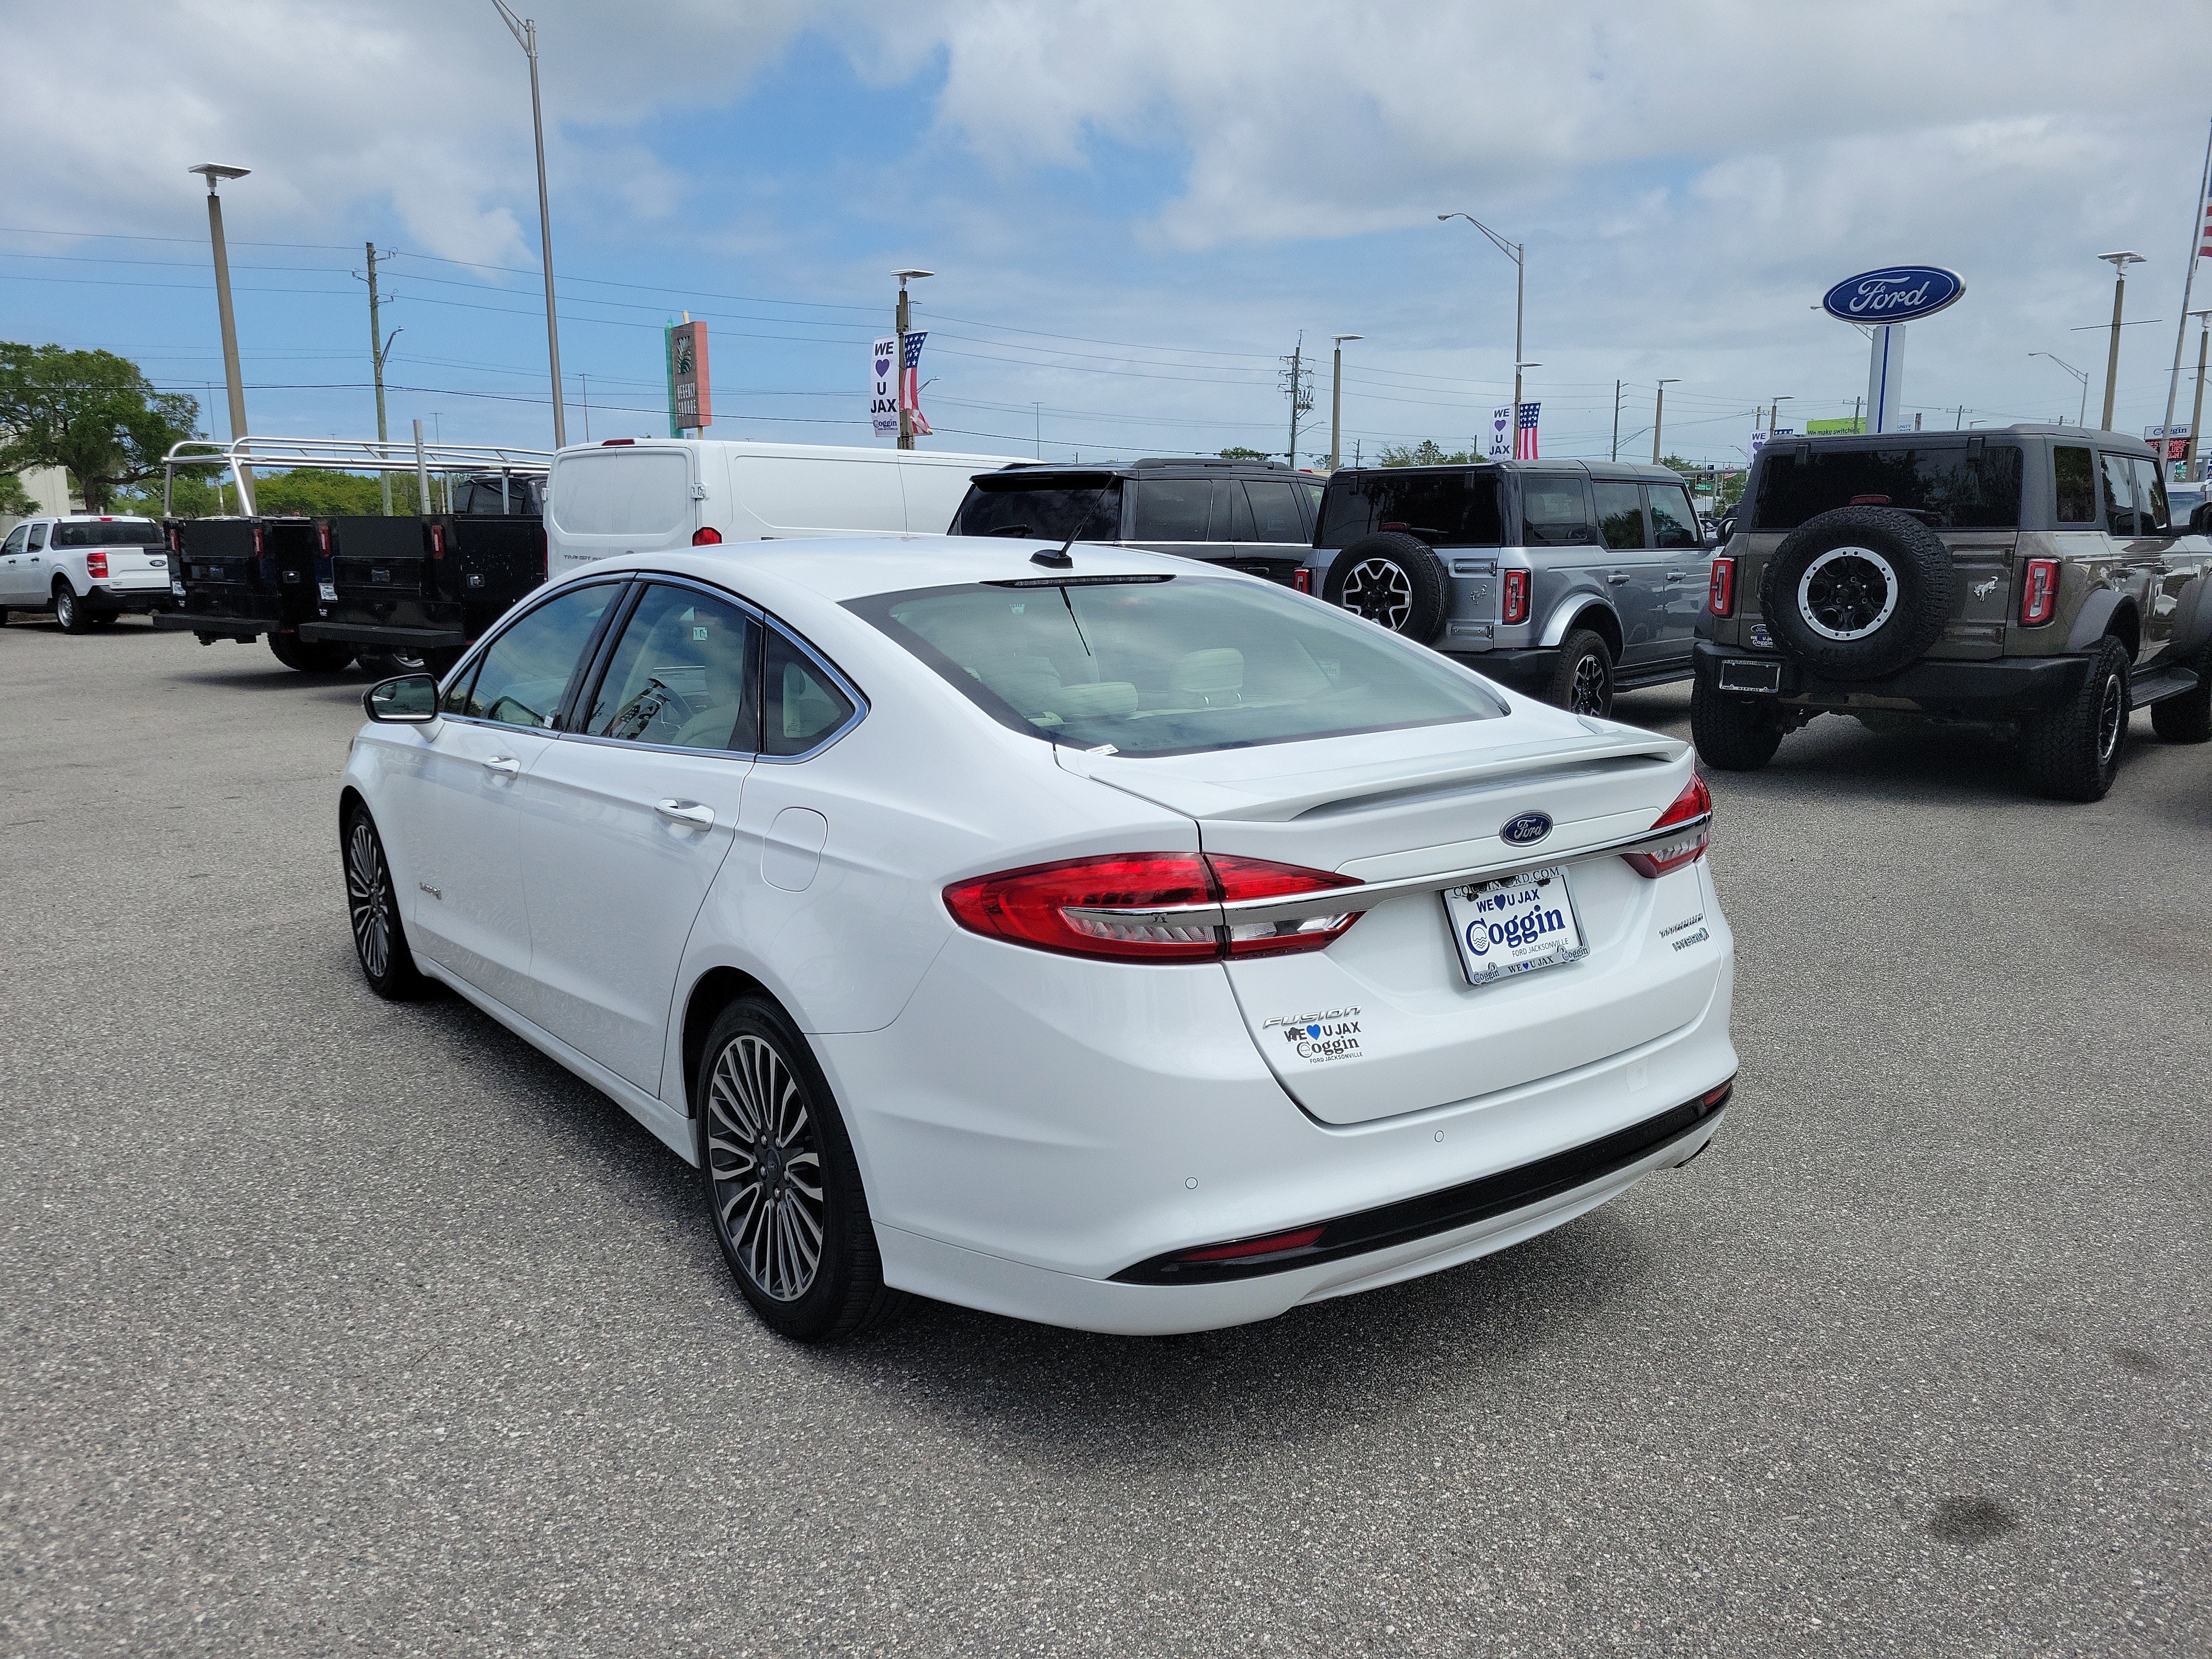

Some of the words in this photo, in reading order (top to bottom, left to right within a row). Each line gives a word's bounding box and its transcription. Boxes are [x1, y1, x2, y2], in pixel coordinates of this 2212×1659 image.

[1849, 276, 1931, 312] Ford
[874, 341, 894, 356] WE
[677, 382, 695, 399] REGENCY
[877, 382, 887, 395] U
[678, 399, 696, 417] SQUARE
[871, 399, 897, 413] JAX
[1494, 408, 1510, 418] WE
[873, 419, 897, 428] Coggin
[2153, 427, 2187, 436] Cgin
[1496, 435, 1503, 443] U
[1489, 445, 1510, 455] JAX
[1514, 818, 1544, 839] Ford
[1476, 898, 1494, 913] WE
[1508, 893, 1515, 906] U
[1517, 888, 1541, 904] JAX
[1466, 904, 1566, 956] Coggin
[1511, 949, 1527, 958] FORD
[1528, 938, 1569, 955] JACKSONVILLE
[1474, 969, 1500, 983] Coggin
[1508, 965, 1522, 974] WE
[1537, 956, 1554, 966] JAX
[1562, 947, 1589, 961] Coggin
[1262, 1005, 1362, 1030] FUSION
[1322, 1025, 1333, 1037] U
[1335, 1021, 1362, 1036] JAX
[1296, 1035, 1360, 1058] Coggin
[1310, 1056, 1324, 1064] FORD
[1325, 1051, 1363, 1062] JACKSONVILLE
